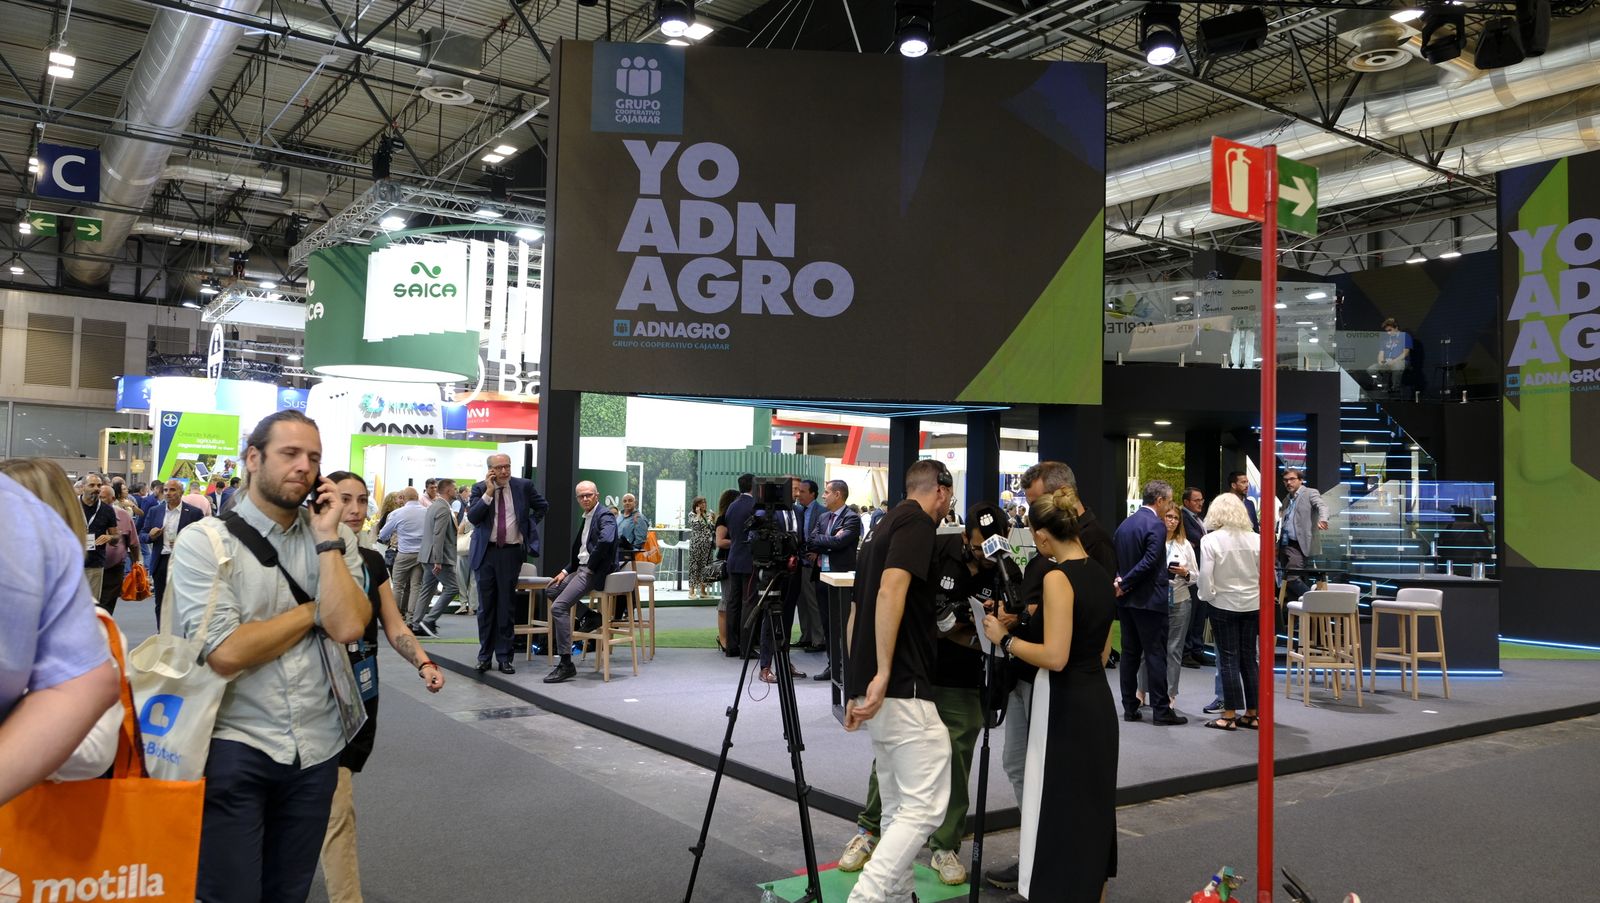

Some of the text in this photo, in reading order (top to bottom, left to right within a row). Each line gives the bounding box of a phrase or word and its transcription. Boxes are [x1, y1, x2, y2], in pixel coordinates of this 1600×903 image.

[615, 98, 661, 110] GRUPO
[615, 108, 661, 116] COOPERATIVO
[615, 114, 661, 125] CAJAMAR
[52, 154, 86, 193] C
[622, 138, 740, 198] YO
[616, 197, 796, 258] ADN
[1508, 217, 1600, 273] YO
[393, 282, 457, 298] SAICA
[615, 255, 855, 318] AGRO
[632, 320, 731, 340] ADNAGRO
[612, 340, 730, 351] GRUPO COOPERATIVO CAJAMAR
[32, 863, 165, 903] motilla
